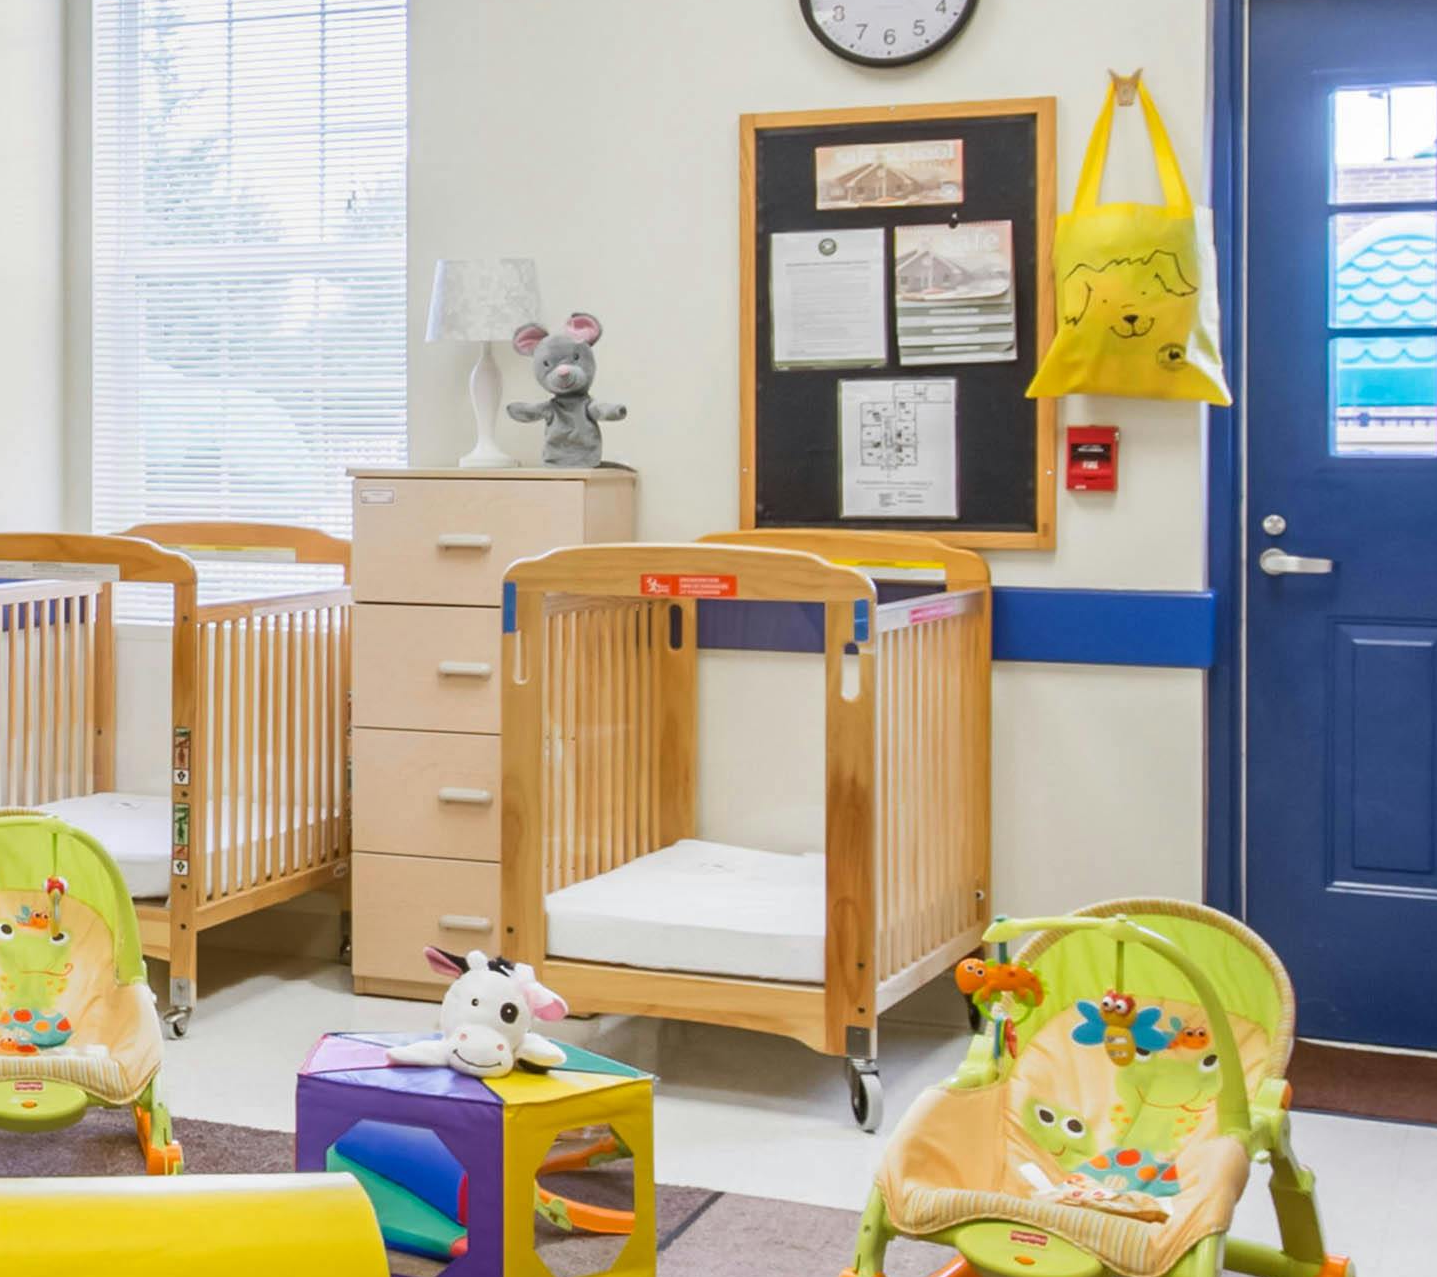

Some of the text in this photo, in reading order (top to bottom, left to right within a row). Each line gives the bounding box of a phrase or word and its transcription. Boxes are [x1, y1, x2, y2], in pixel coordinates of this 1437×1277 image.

[856, 23, 868, 40] 7
[913, 19, 925, 37] 5
[883, 29, 896, 45] 6
